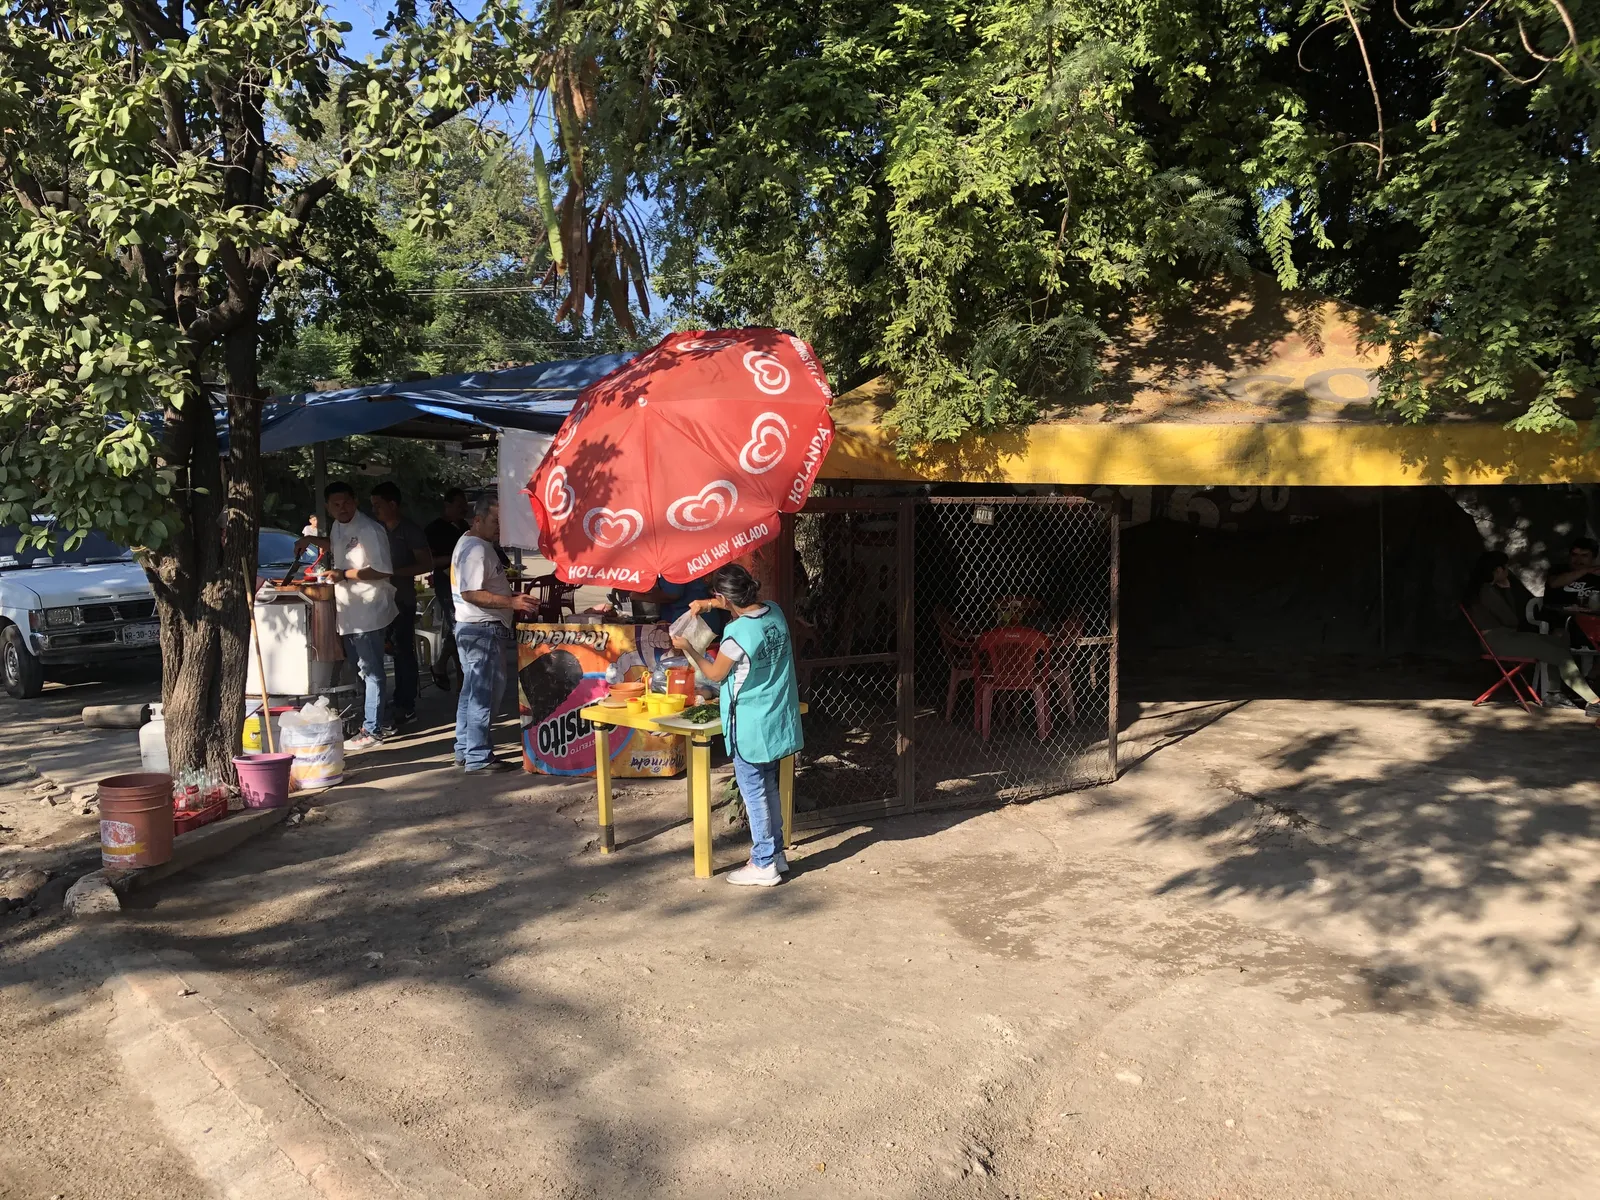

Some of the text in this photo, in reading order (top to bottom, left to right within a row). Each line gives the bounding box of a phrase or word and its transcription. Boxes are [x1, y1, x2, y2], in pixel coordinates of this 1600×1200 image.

[788, 427, 831, 505] HOLANDA
[568, 565, 641, 583] HOLANDA
[687, 523, 768, 575] AQUÍ HAY HELADO
[538, 704, 612, 756] nsito
[569, 738, 596, 755] STELITO
